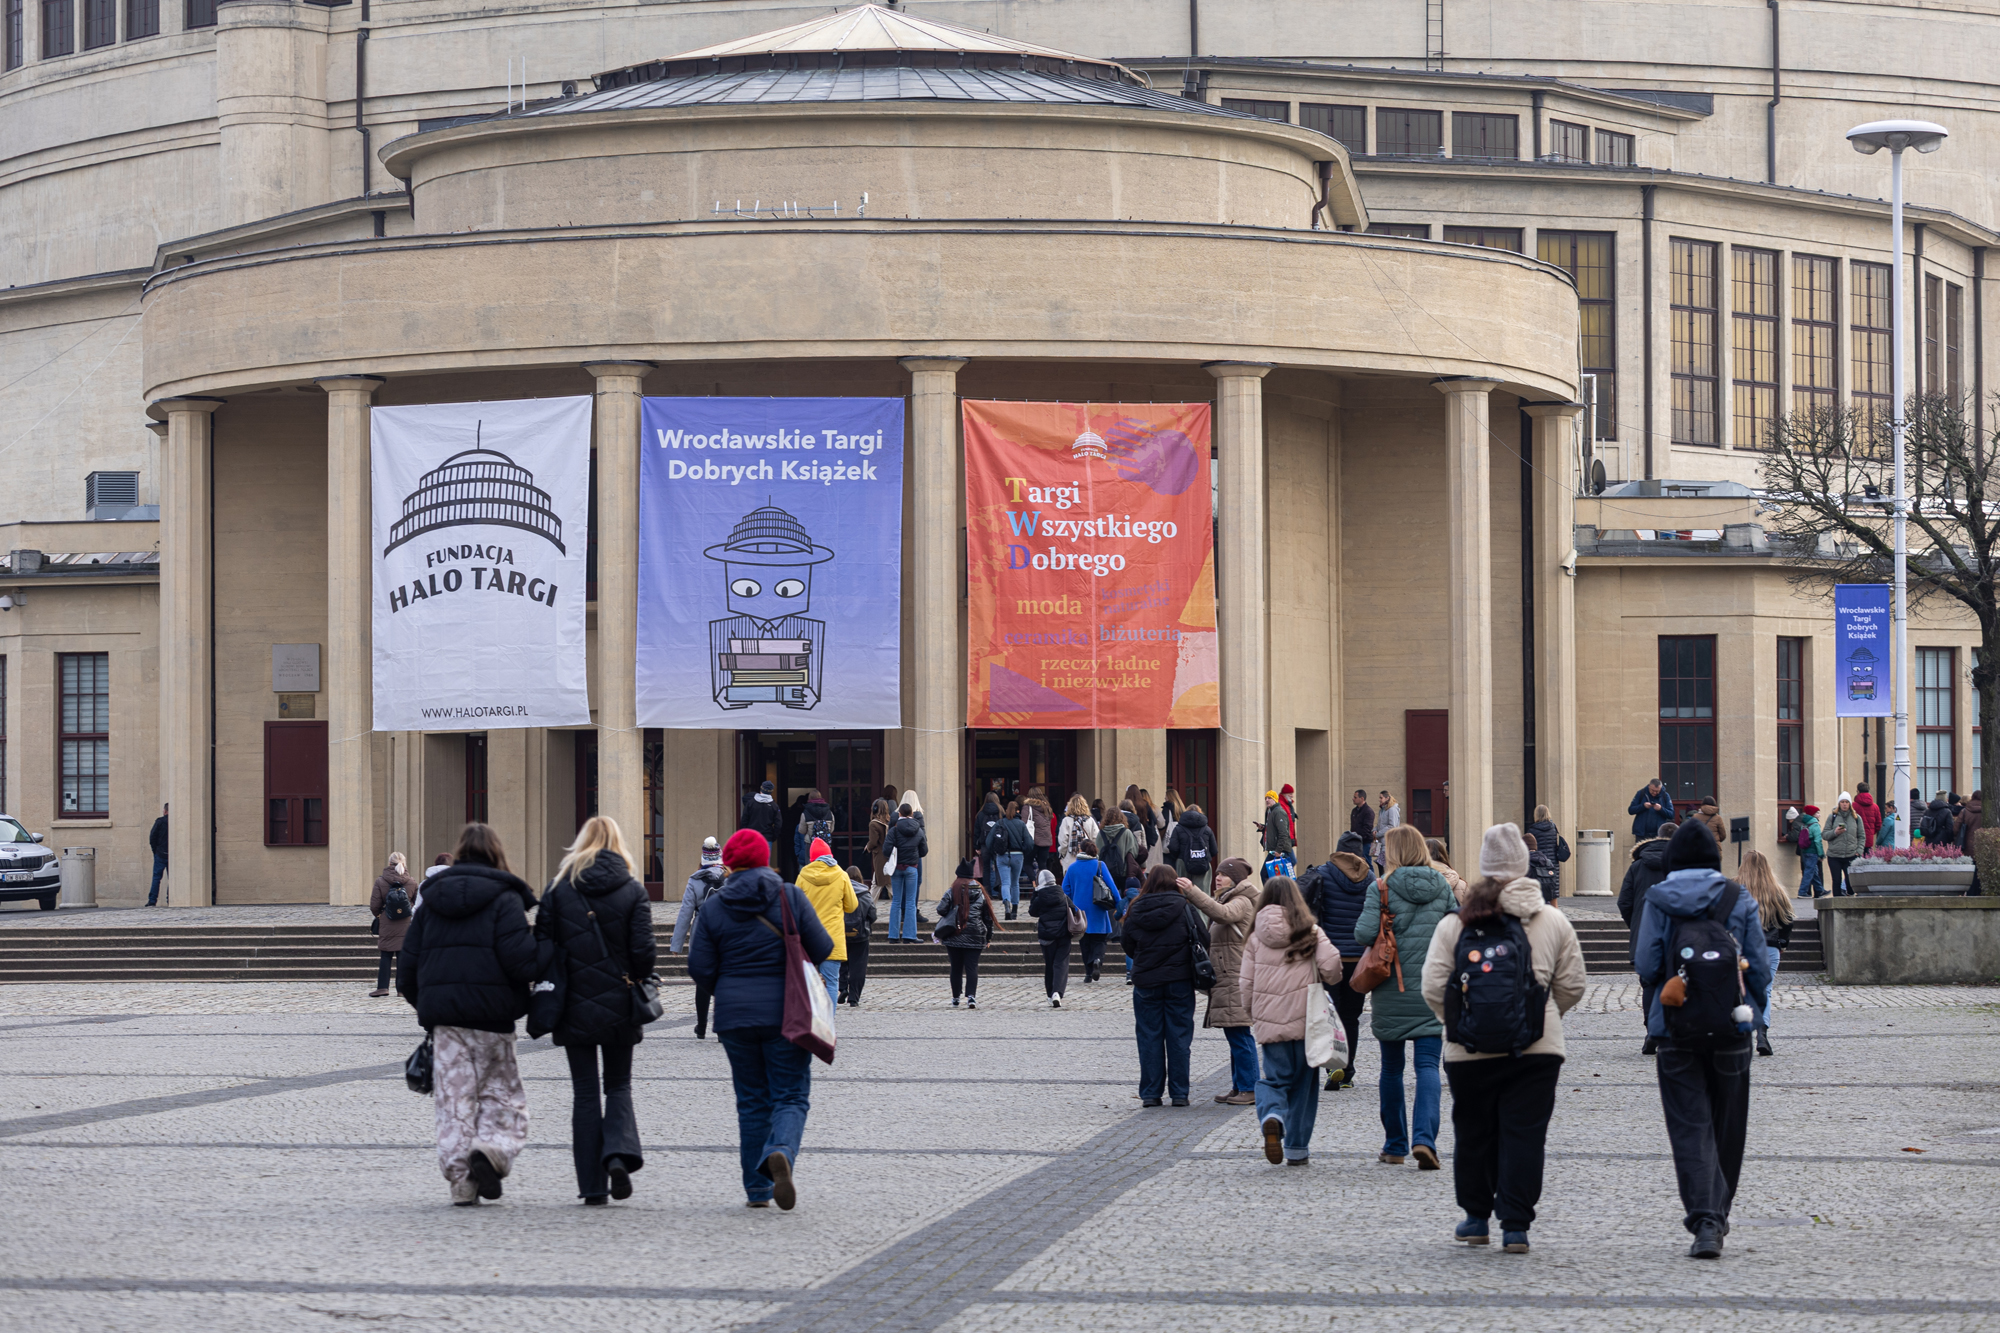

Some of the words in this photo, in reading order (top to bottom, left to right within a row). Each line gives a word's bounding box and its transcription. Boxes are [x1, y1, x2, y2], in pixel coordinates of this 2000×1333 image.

[657, 429, 815, 450] Wrocławskie
[822, 429, 883, 455] Targi
[668, 459, 774, 486] Dobrych
[781, 459, 878, 486] Książek
[1005, 477, 1082, 510] Targi
[1005, 511, 1178, 544] Wszystkiego
[426, 544, 514, 569] FUNDACJA
[1007, 544, 1126, 577] Dobrego
[389, 568, 463, 614] HALO
[470, 567, 558, 608] TARGI
[1101, 579, 1170, 601] kosmetyki
[1016, 594, 1083, 615] moda
[1103, 596, 1170, 615] naturalne
[1846, 623, 1878, 632] Dobrych
[1853, 615, 1872, 623] Targi
[1004, 628, 1088, 645] ceramika
[1099, 624, 1182, 641] biżuteria
[1848, 631, 1877, 640] Książek
[1040, 658, 1102, 674] rzeczy
[1107, 655, 1161, 671] ładne
[1040, 672, 1047, 688] i
[1052, 672, 1152, 692] niezwykłe
[421, 705, 529, 719] WWW.HALOTARGI.PL
